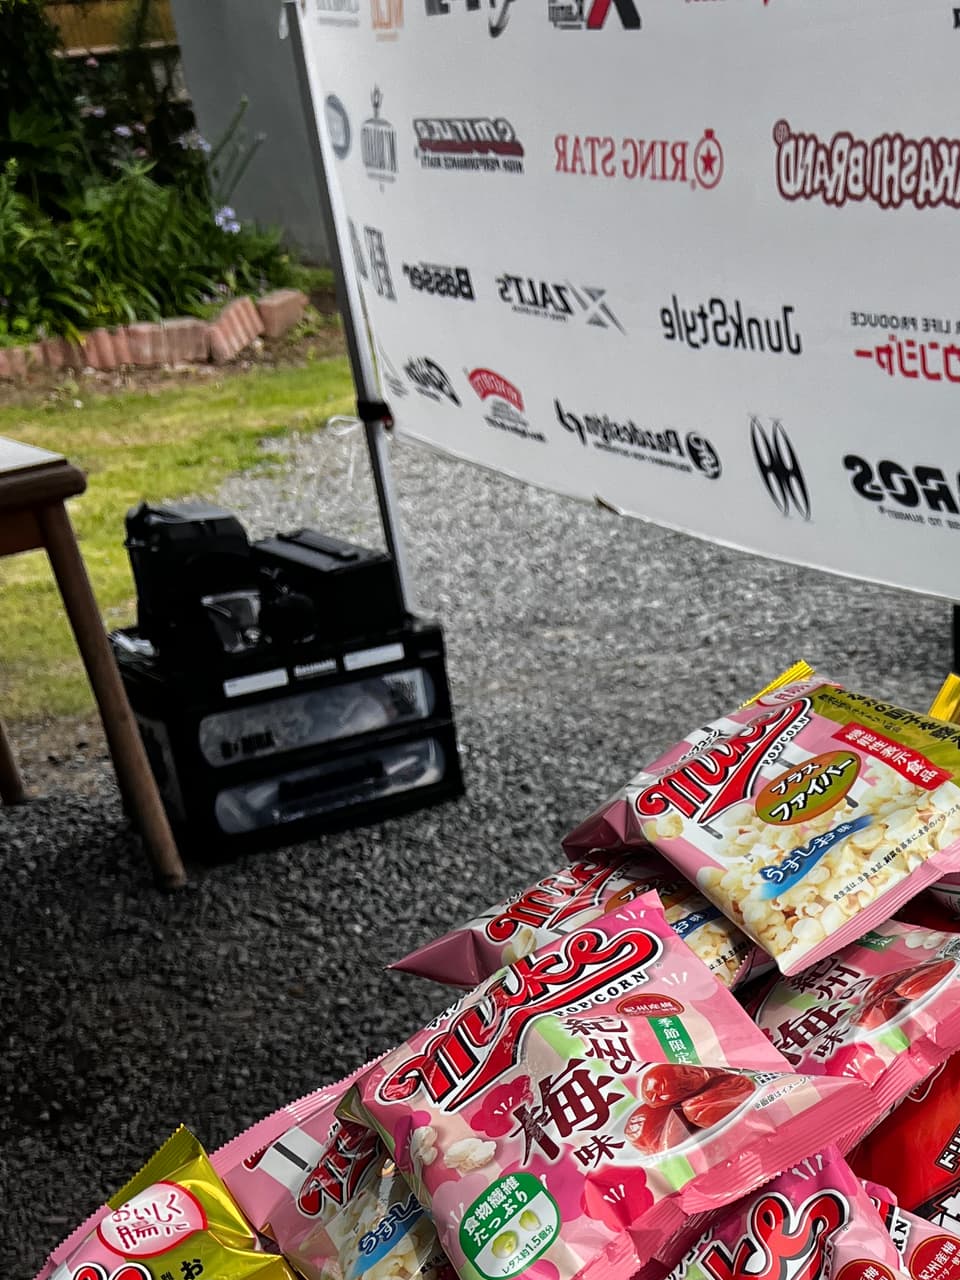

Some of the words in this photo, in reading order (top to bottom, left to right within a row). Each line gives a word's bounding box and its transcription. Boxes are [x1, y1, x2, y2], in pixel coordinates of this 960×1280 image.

[770, 762, 823, 796] プラス
[843, 727, 939, 785] 機能性表示食品
[769, 757, 856, 823] ファイバー
[377, 928, 662, 1113] Mike
[658, 1017, 693, 1065] 季節限定
[111, 1192, 184, 1224] おいしく
[463, 1175, 521, 1237] 食物繊維
[473, 1189, 529, 1248] たっぷり
[501, 1224, 554, 1275] レタス約1.5個分
[919, 1240, 958, 1280] 紀州産梅
